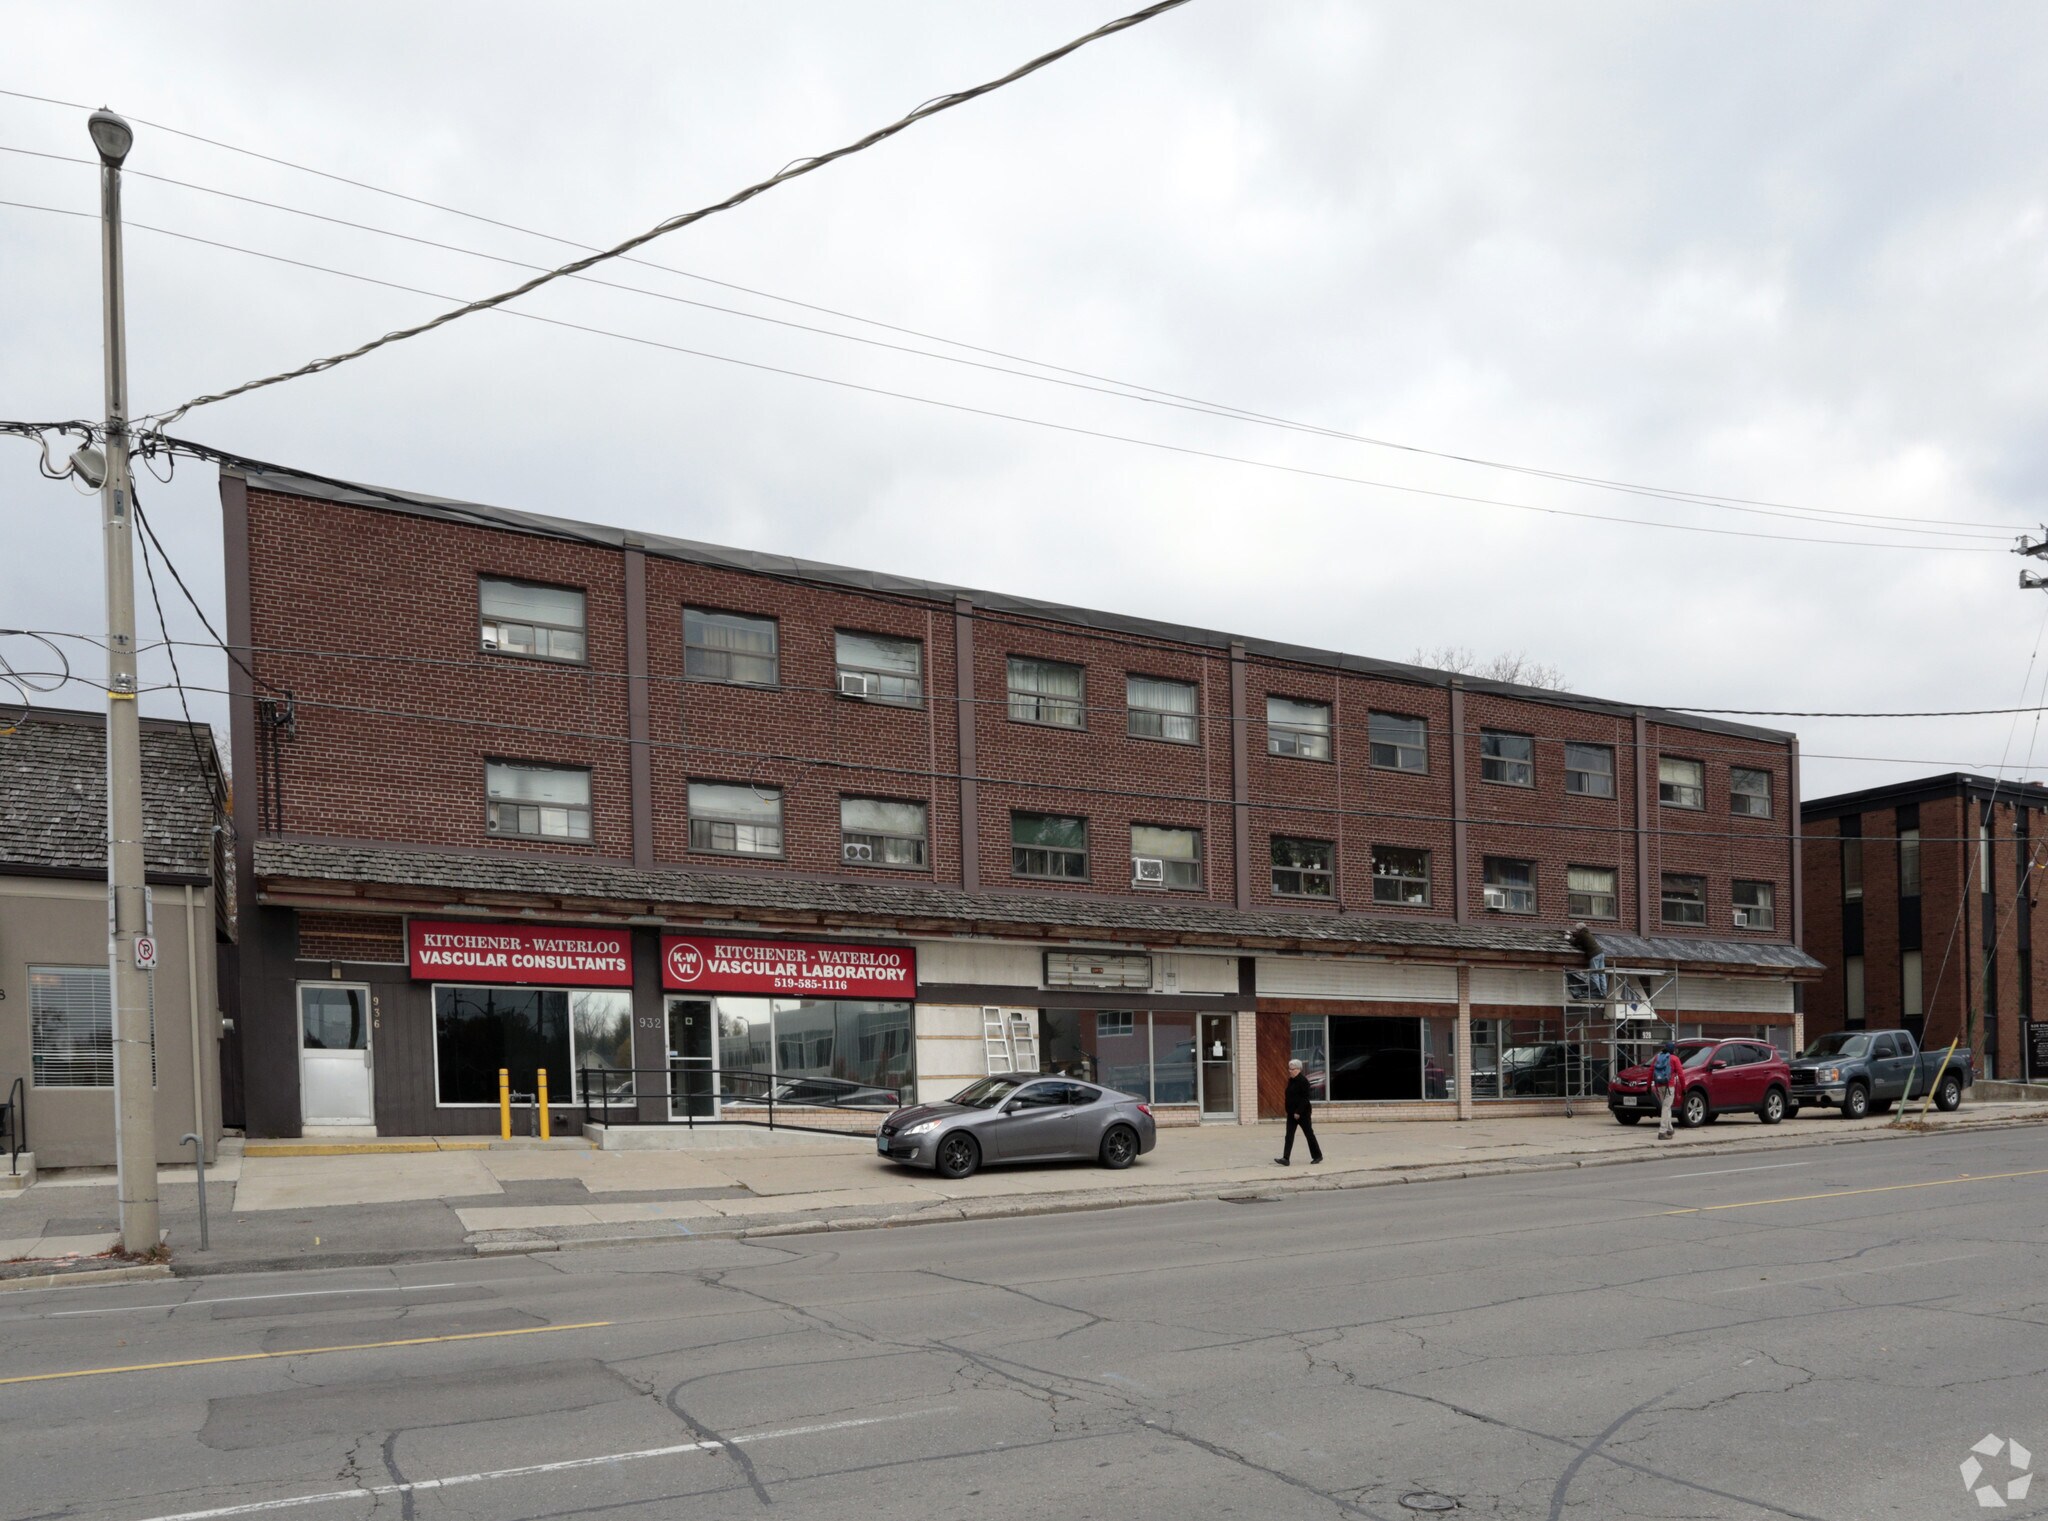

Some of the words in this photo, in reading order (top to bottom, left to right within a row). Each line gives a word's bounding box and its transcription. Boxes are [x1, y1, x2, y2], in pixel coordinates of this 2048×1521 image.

[423, 933, 521, 950] KITCHENER
[532, 938, 620, 954] WATERLOO
[419, 950, 508, 966] VASCULAR
[511, 954, 626, 971] CONSULTANTS
[673, 952, 697, 963] K-W
[714, 945, 807, 961] KITCHENER
[818, 951, 900, 966] WATERLOO
[678, 963, 694, 974] VL
[706, 959, 797, 976] VASCULAR
[802, 965, 907, 980] LABORATORY
[774, 977, 847, 990] 519-585-1116
[639, 1017, 661, 1029] 932
